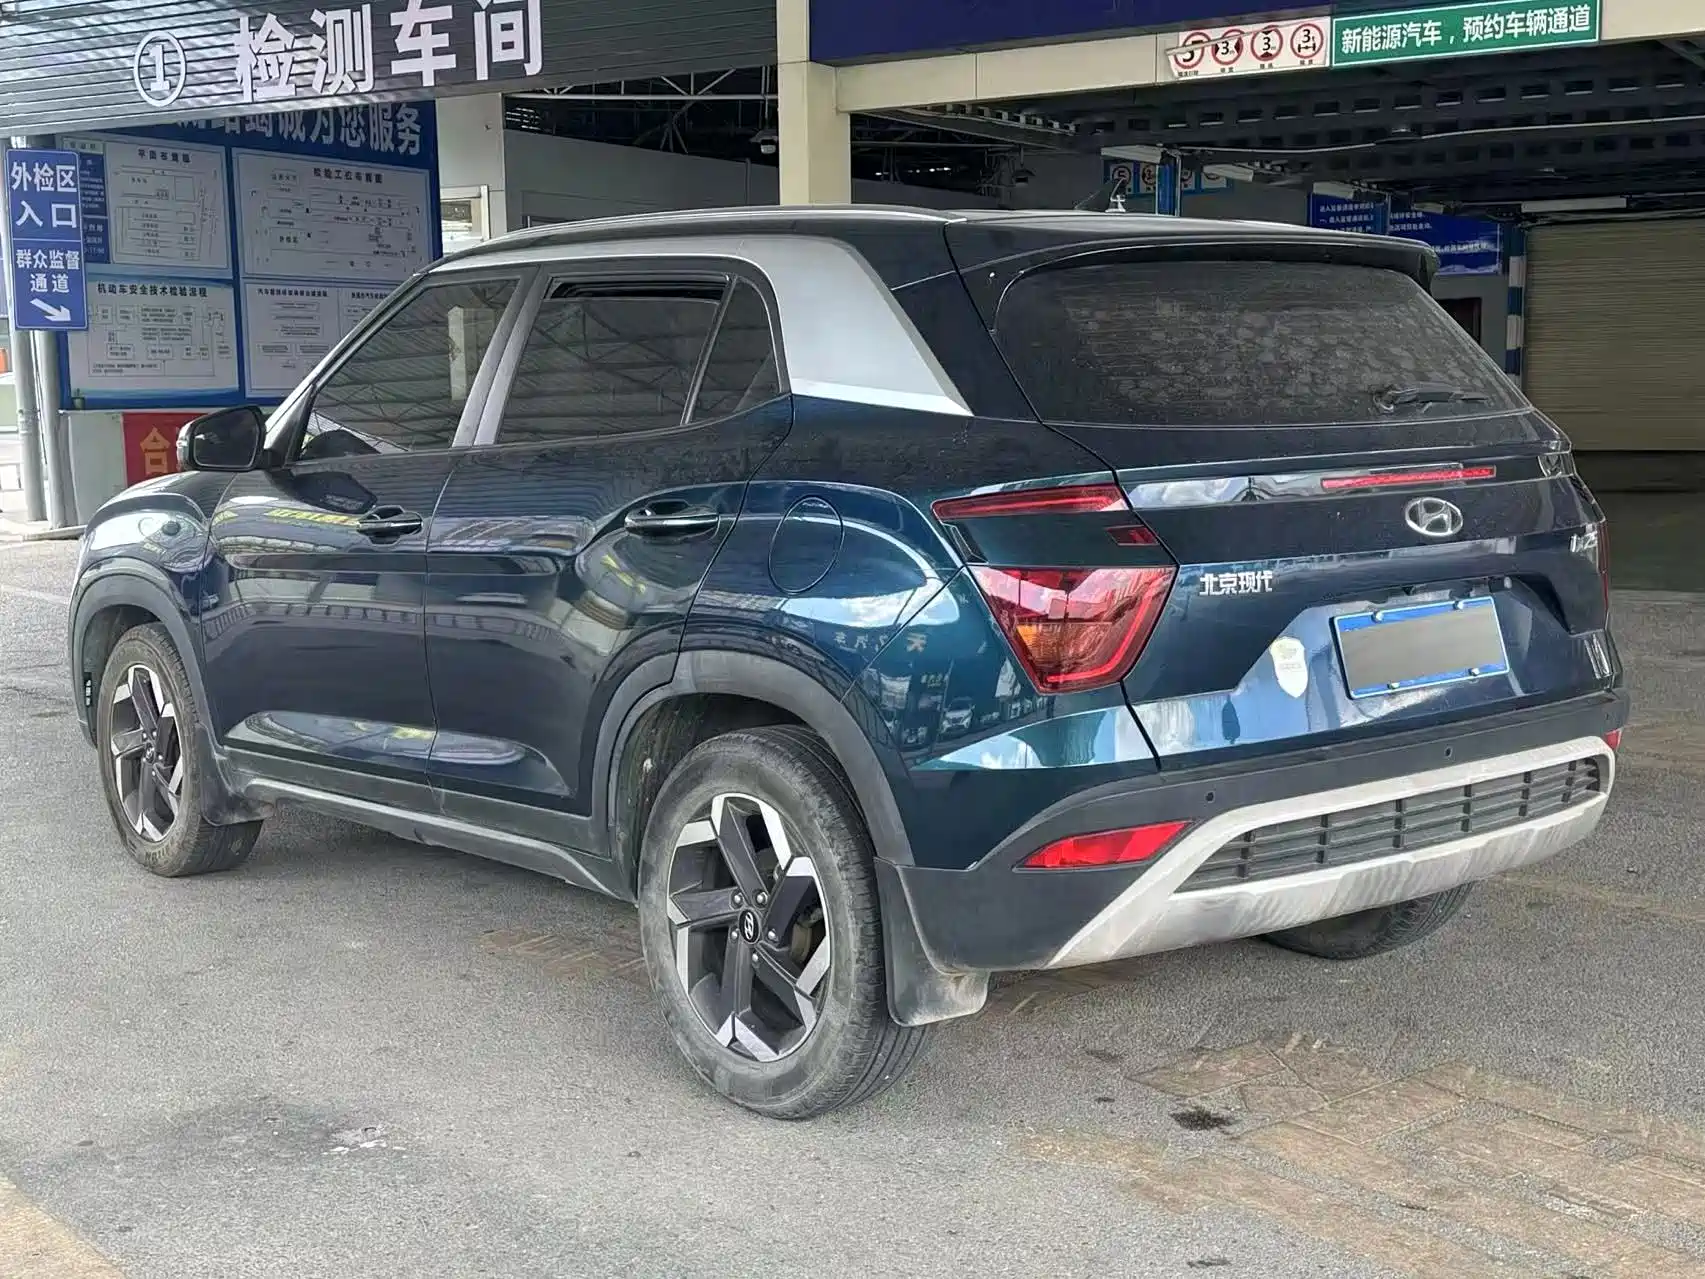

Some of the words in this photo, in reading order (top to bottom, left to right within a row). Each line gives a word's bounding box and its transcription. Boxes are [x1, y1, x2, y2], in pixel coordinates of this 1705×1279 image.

[234, 0, 543, 102] 检测车间
[11, 162, 77, 192] 外检区
[16, 200, 77, 228] 入口
[16, 249, 80, 270] 群众监督
[30, 274, 70, 293] 通道
[1199, 570, 1273, 596] 北京现代
